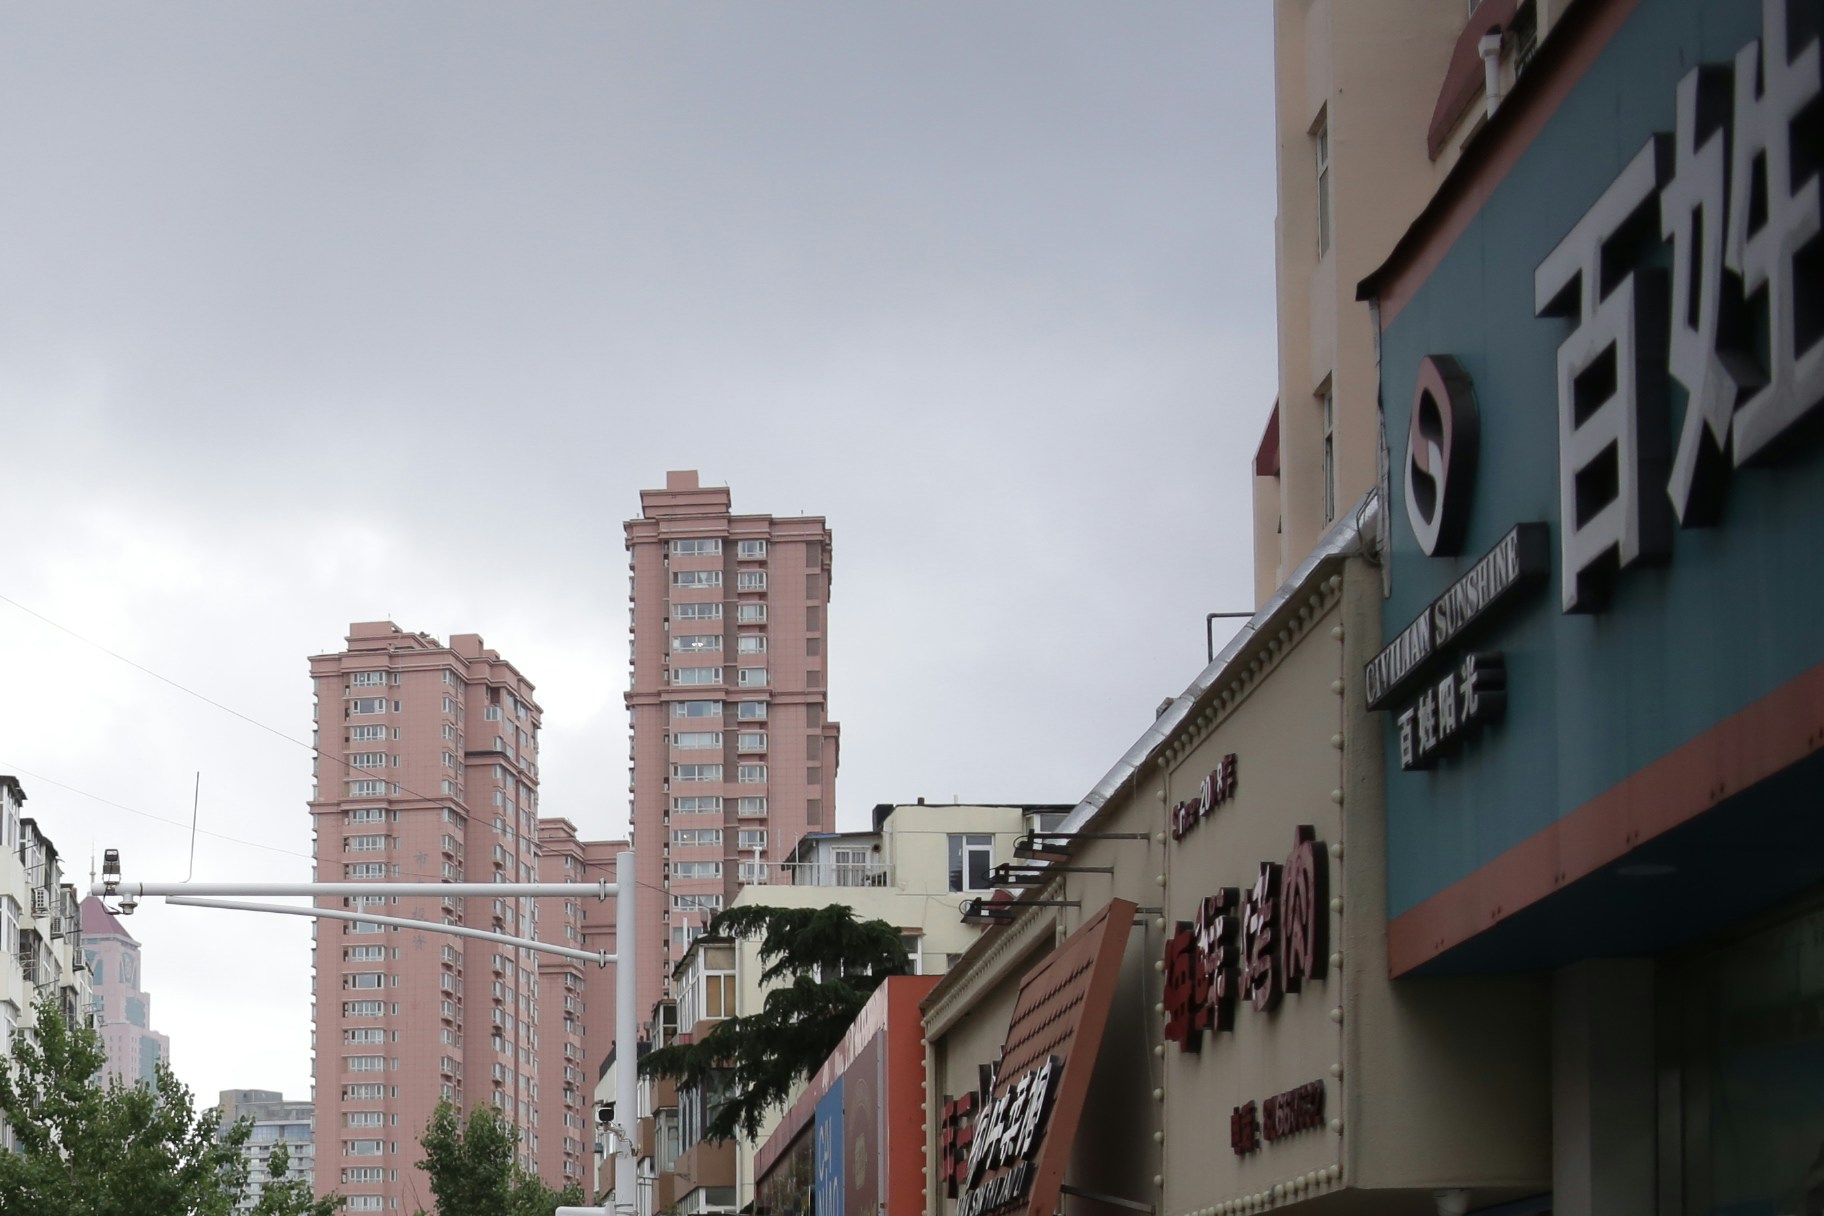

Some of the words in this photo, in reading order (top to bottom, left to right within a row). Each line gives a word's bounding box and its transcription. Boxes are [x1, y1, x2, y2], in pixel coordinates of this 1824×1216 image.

[1534, 0, 1824, 614] 百姓
[1365, 606, 1432, 704] CIVILIAN
[1433, 530, 1520, 648] SUNSHINE
[1397, 653, 1479, 770] 百姓阳光
